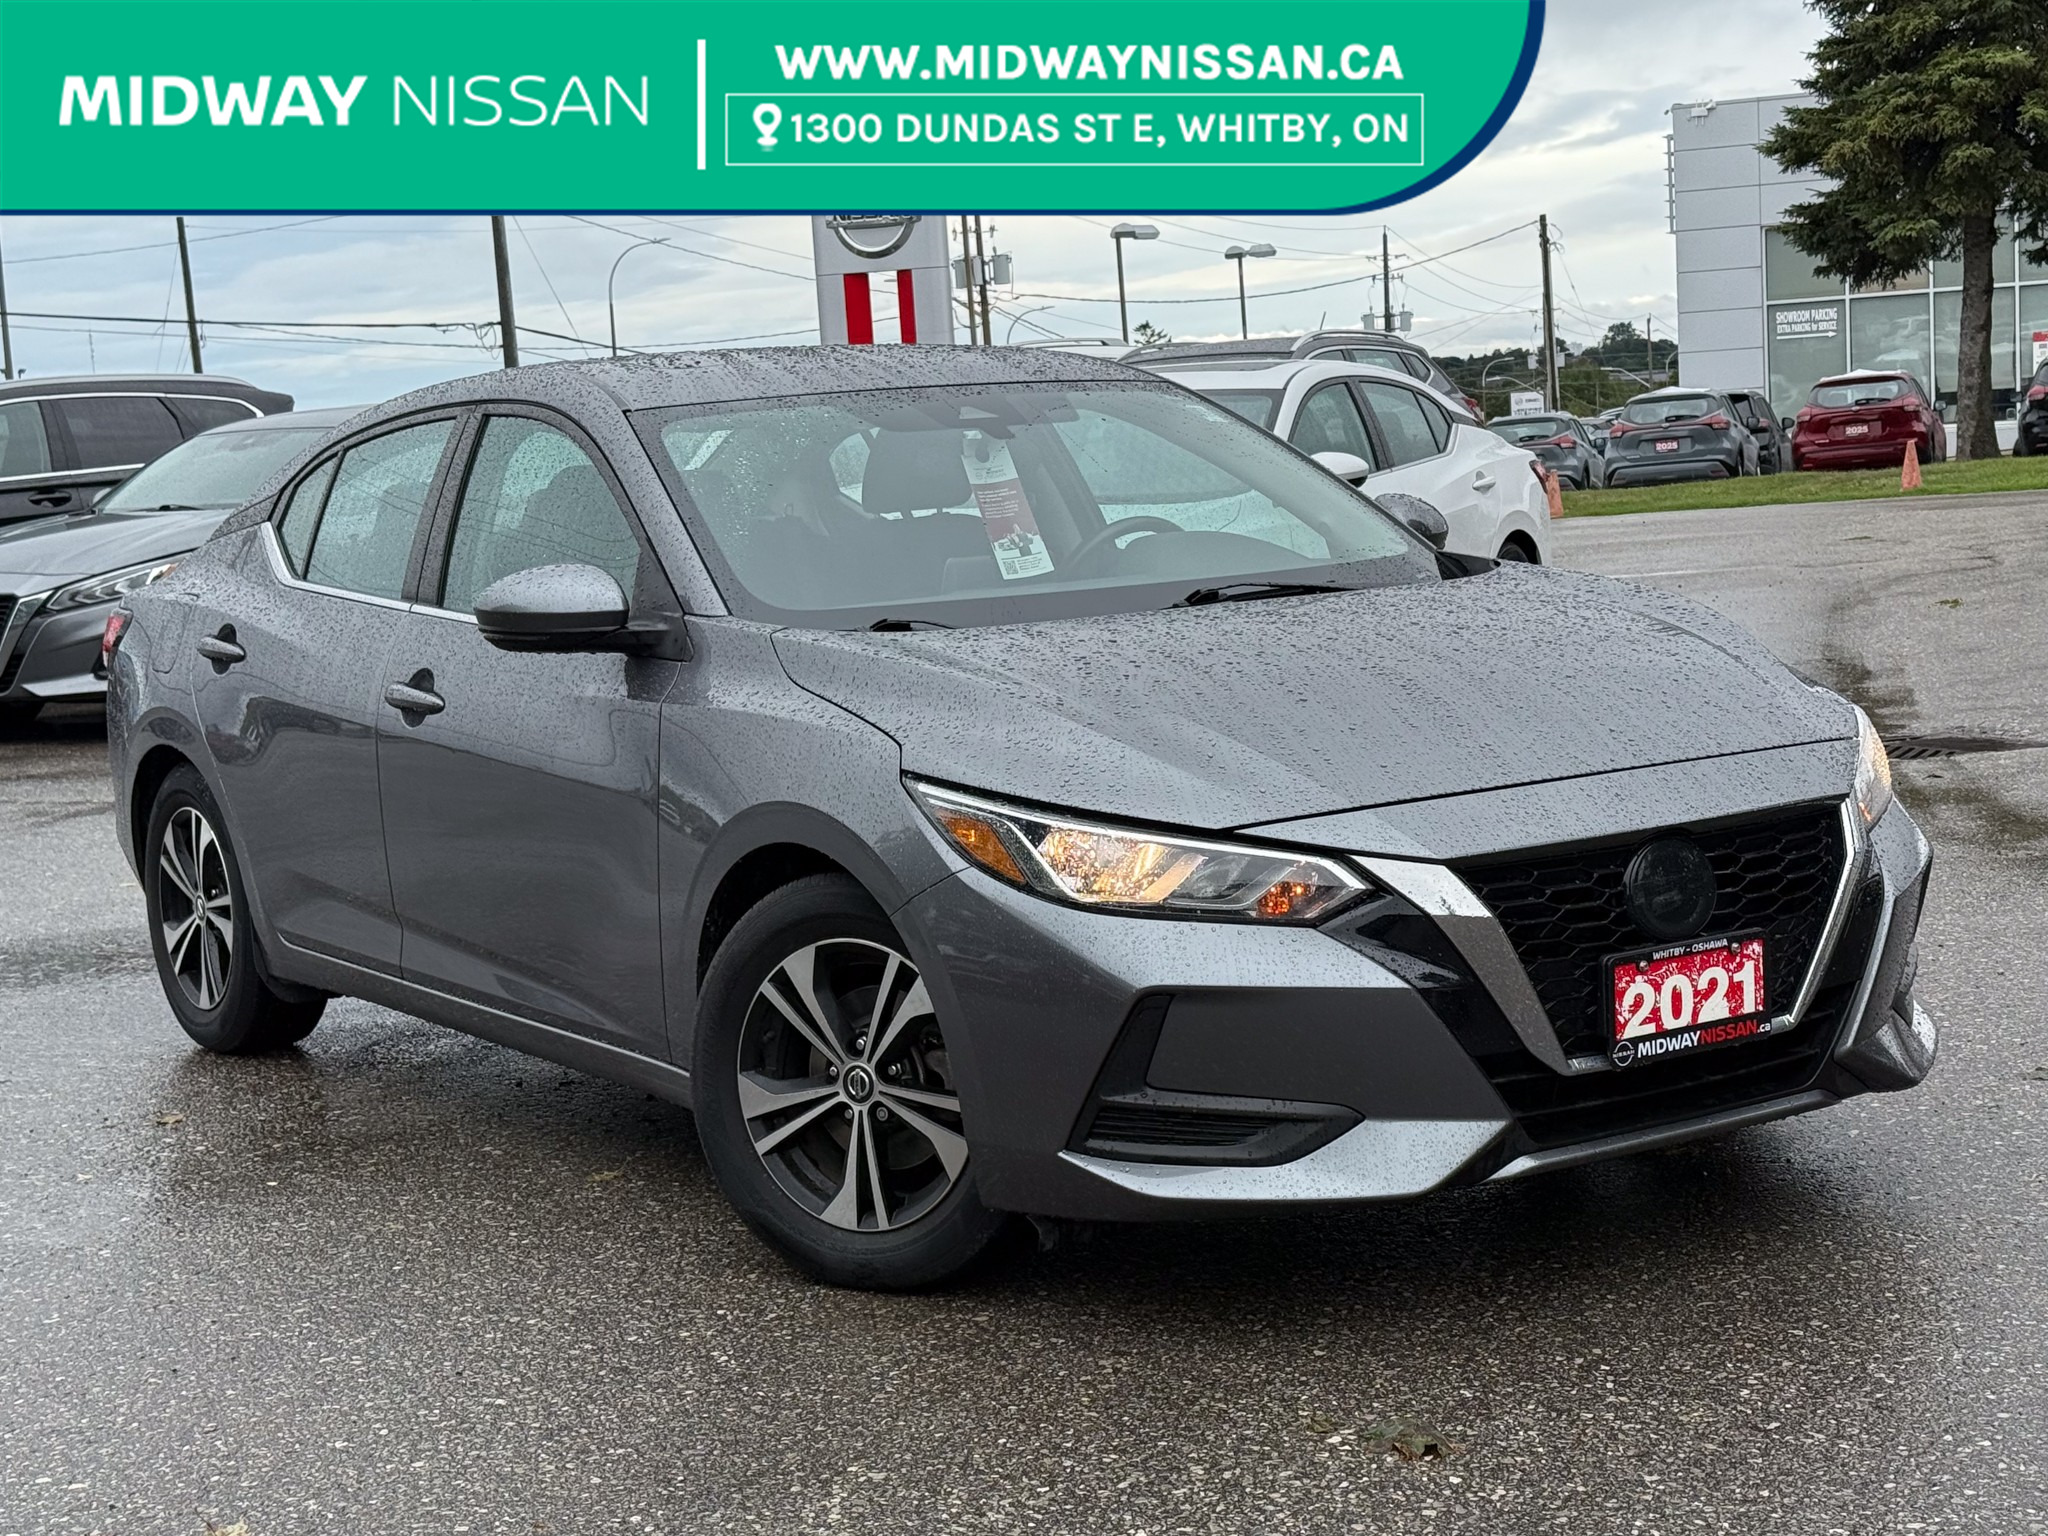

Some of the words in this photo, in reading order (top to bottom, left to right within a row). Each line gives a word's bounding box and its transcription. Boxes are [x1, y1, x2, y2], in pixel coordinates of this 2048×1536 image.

[1776, 310, 1810, 324] SHOWROOM
[1811, 308, 1838, 321] PARKING
[1777, 324, 1791, 333] EXTRA
[1791, 322, 1811, 332] PARKING
[1818, 321, 1837, 331] SERVICE
[1845, 425, 1869, 435] 2025
[1656, 441, 1679, 450] 2025
[1652, 946, 1686, 960] WHITBY
[1691, 938, 1728, 953] OSHAWA
[1622, 960, 1756, 1040] 2021
